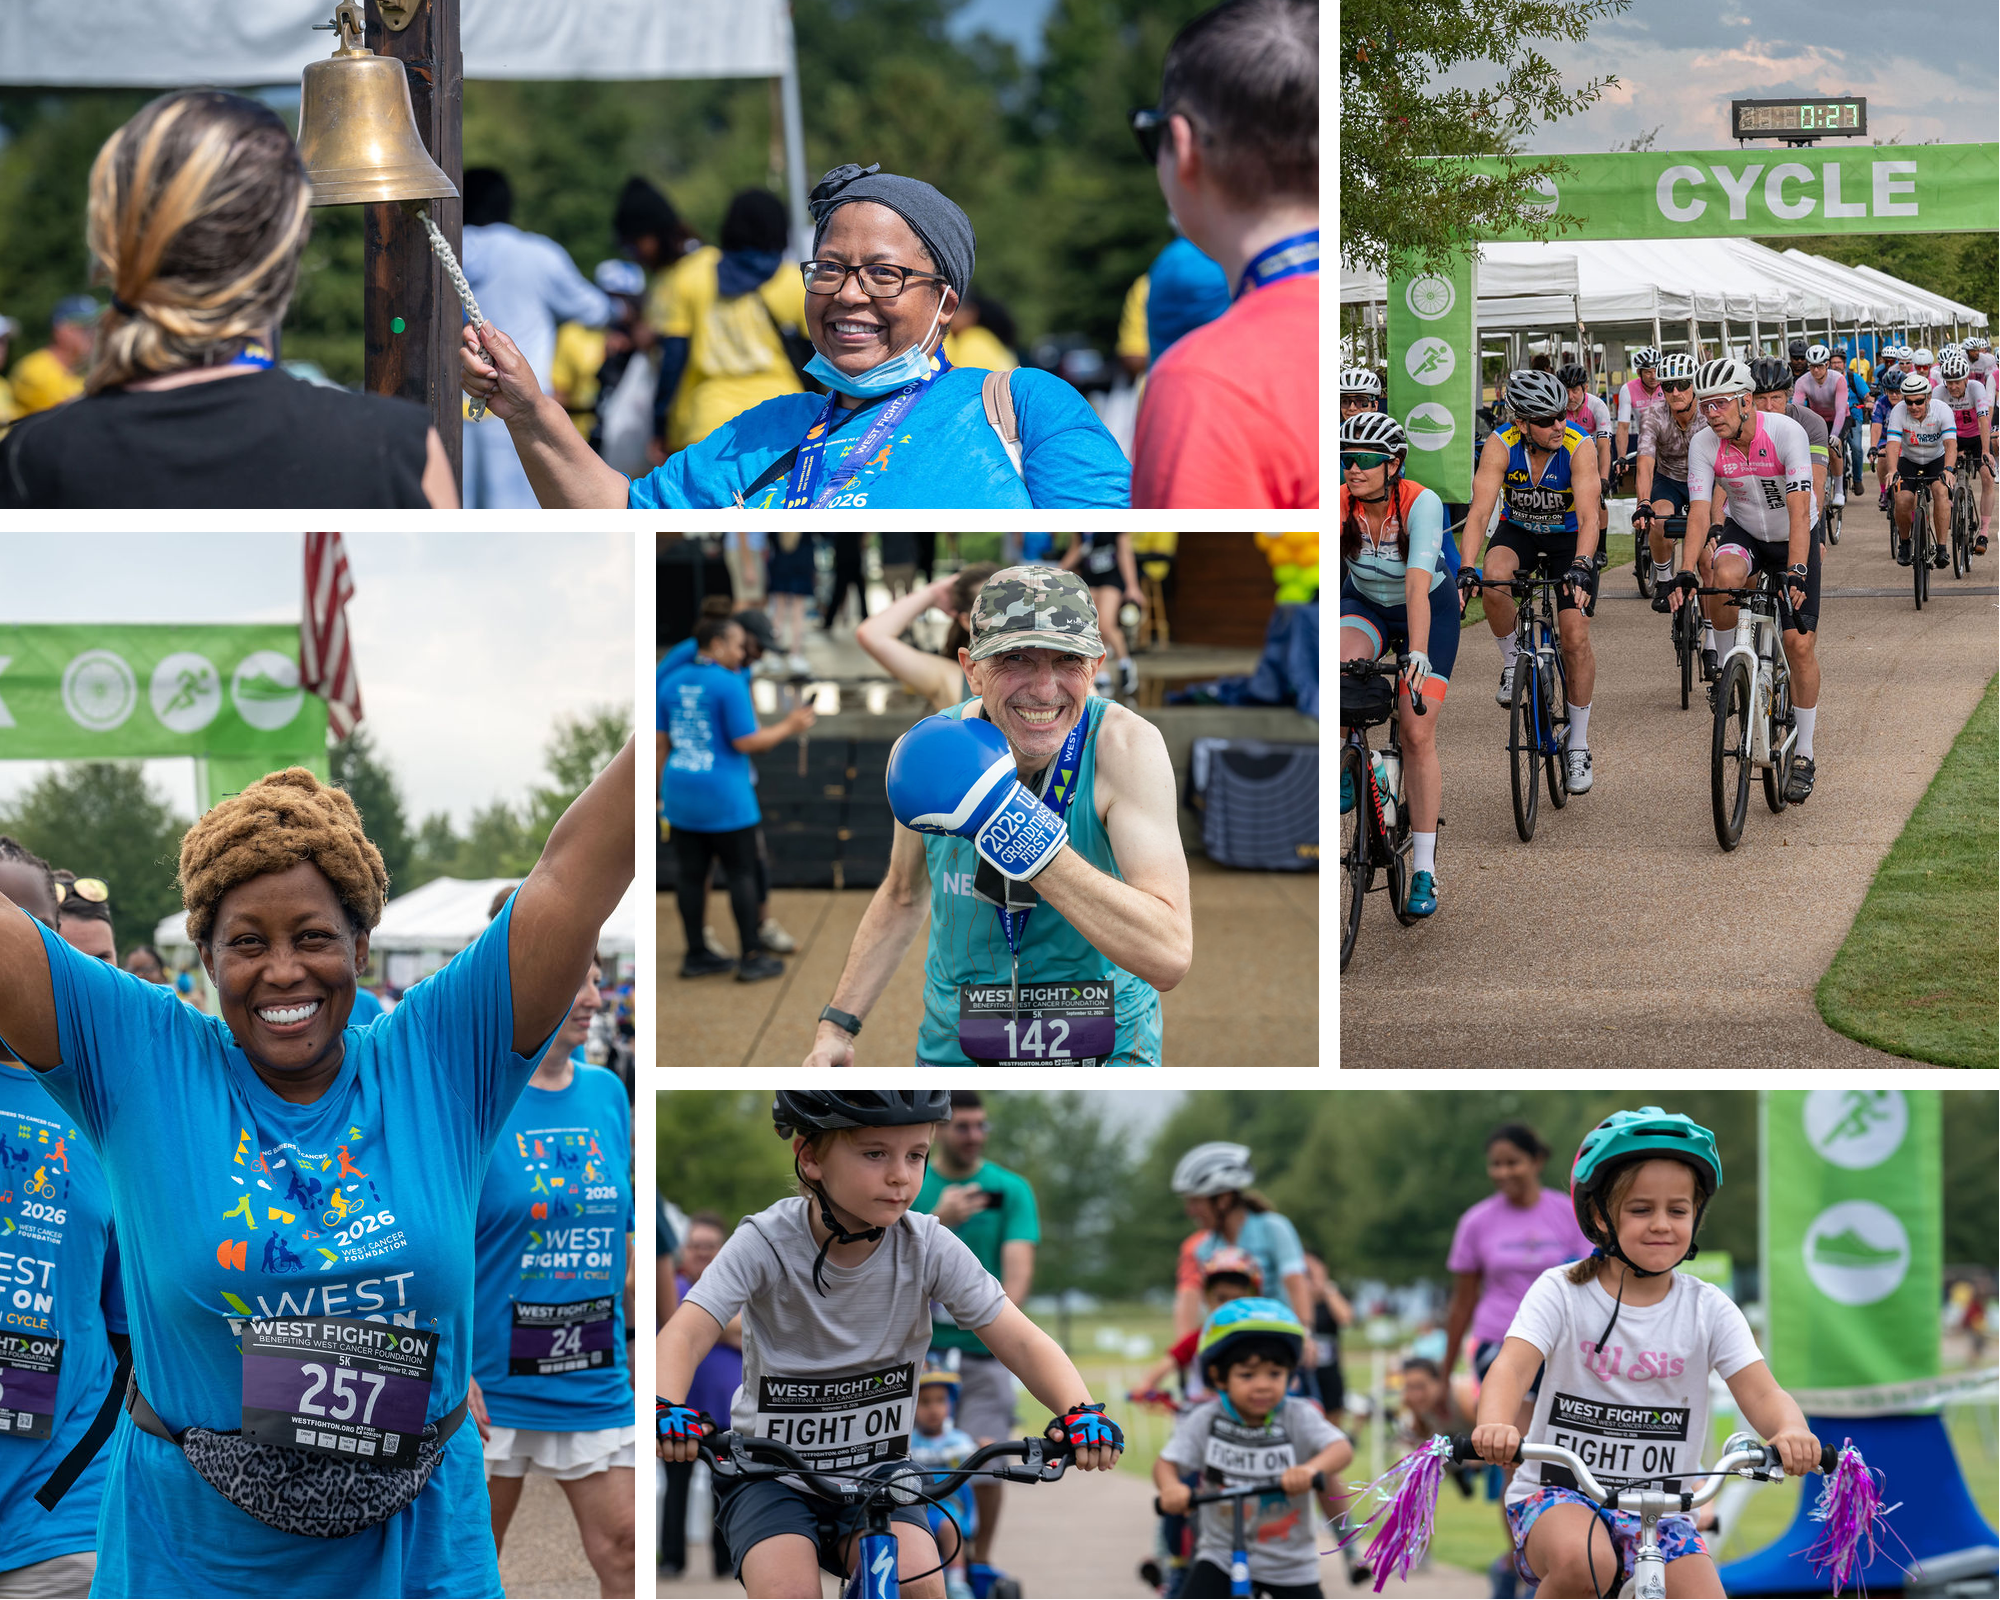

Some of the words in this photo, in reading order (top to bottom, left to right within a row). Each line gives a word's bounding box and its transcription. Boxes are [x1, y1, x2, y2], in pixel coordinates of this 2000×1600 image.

[1801, 105, 1858, 129] 0:27
[1656, 160, 1919, 222] CYCLE
[855, 428, 880, 454] WEST
[876, 399, 902, 427] FIGHT
[902, 380, 919, 395] ON
[1511, 489, 1565, 510] PEDDLER
[1512, 509, 1528, 519] WEST
[1523, 522, 1551, 534] 943
[1063, 730, 1077, 762] WEST
[980, 811, 1027, 855] 2026
[1001, 801, 1053, 865] GRANDMAS
[1018, 830, 1050, 866] FIRST
[943, 871, 976, 897] NE
[969, 989, 1013, 1003] WEST
[1020, 987, 1070, 1002] FIGHT
[1083, 986, 1109, 1000] ON
[1032, 1000, 1060, 1008] CANCER
[1032, 1010, 1043, 1019] 5K
[1003, 1018, 1071, 1059] 142
[26, 1115, 47, 1125] CANCER
[585, 1186, 618, 1200] 2026
[21, 1200, 67, 1225] 2026
[18, 1230, 62, 1245] FOUNDATION
[19, 1223, 36, 1233] WEST
[37, 1228, 63, 1239] CANCER
[334, 1210, 396, 1247] 2026
[546, 1228, 615, 1250] WEST
[341, 1245, 367, 1257] WEST
[368, 1231, 405, 1250] CANCER
[344, 1240, 408, 1263] FOUNDATION
[585, 1252, 612, 1267] ON
[13, 1289, 53, 1314] ON
[256, 1271, 415, 1318] WEST
[517, 1303, 555, 1318] WEST
[557, 1302, 588, 1317] FIGHT
[595, 1299, 612, 1311] ON
[7, 1312, 48, 1330] CYCLE
[31, 1341, 56, 1357] ON
[250, 1321, 316, 1338] WEST
[323, 1324, 386, 1347] FIGHT
[400, 1337, 428, 1357] ON
[259, 1335, 311, 1347] BENEFITING
[313, 1340, 337, 1350] WEST
[339, 1344, 373, 1355] CANCER
[374, 1350, 423, 1364] FOUNDATION
[550, 1325, 582, 1357] 24
[8, 1350, 51, 1363] FOUNDATION
[11, 1361, 32, 1369] September
[339, 1355, 351, 1366] 5K
[378, 1364, 401, 1373] September
[1579, 1340, 1624, 1382] Lil
[1627, 1351, 1685, 1382] Sis
[298, 1363, 386, 1425] 257
[767, 1383, 820, 1397] WEST
[824, 1378, 873, 1396] FIGHT
[884, 1371, 907, 1386] ON
[772, 1396, 814, 1404] BENEFITING
[836, 1393, 863, 1402] CANCER
[864, 1384, 903, 1397] FOUNDATION
[1559, 1399, 1604, 1417] WEST
[1606, 1408, 1652, 1423] FIGHT
[1661, 1412, 1683, 1425] ON
[1561, 1411, 1597, 1425] BENEFITING
[1598, 1419, 1616, 1428] WEST
[1617, 1422, 1642, 1430] CANCER
[1643, 1423, 1679, 1431] FOUNDATION
[291, 1416, 355, 1433] WESTFIGHTON.ORG
[767, 1415, 857, 1445] FIGHT
[864, 1405, 902, 1437] ON
[1212, 1443, 1256, 1470] FIGHT
[1264, 1452, 1290, 1470] ON
[1555, 1433, 1635, 1471] FIGHT
[1642, 1446, 1676, 1474] ON
